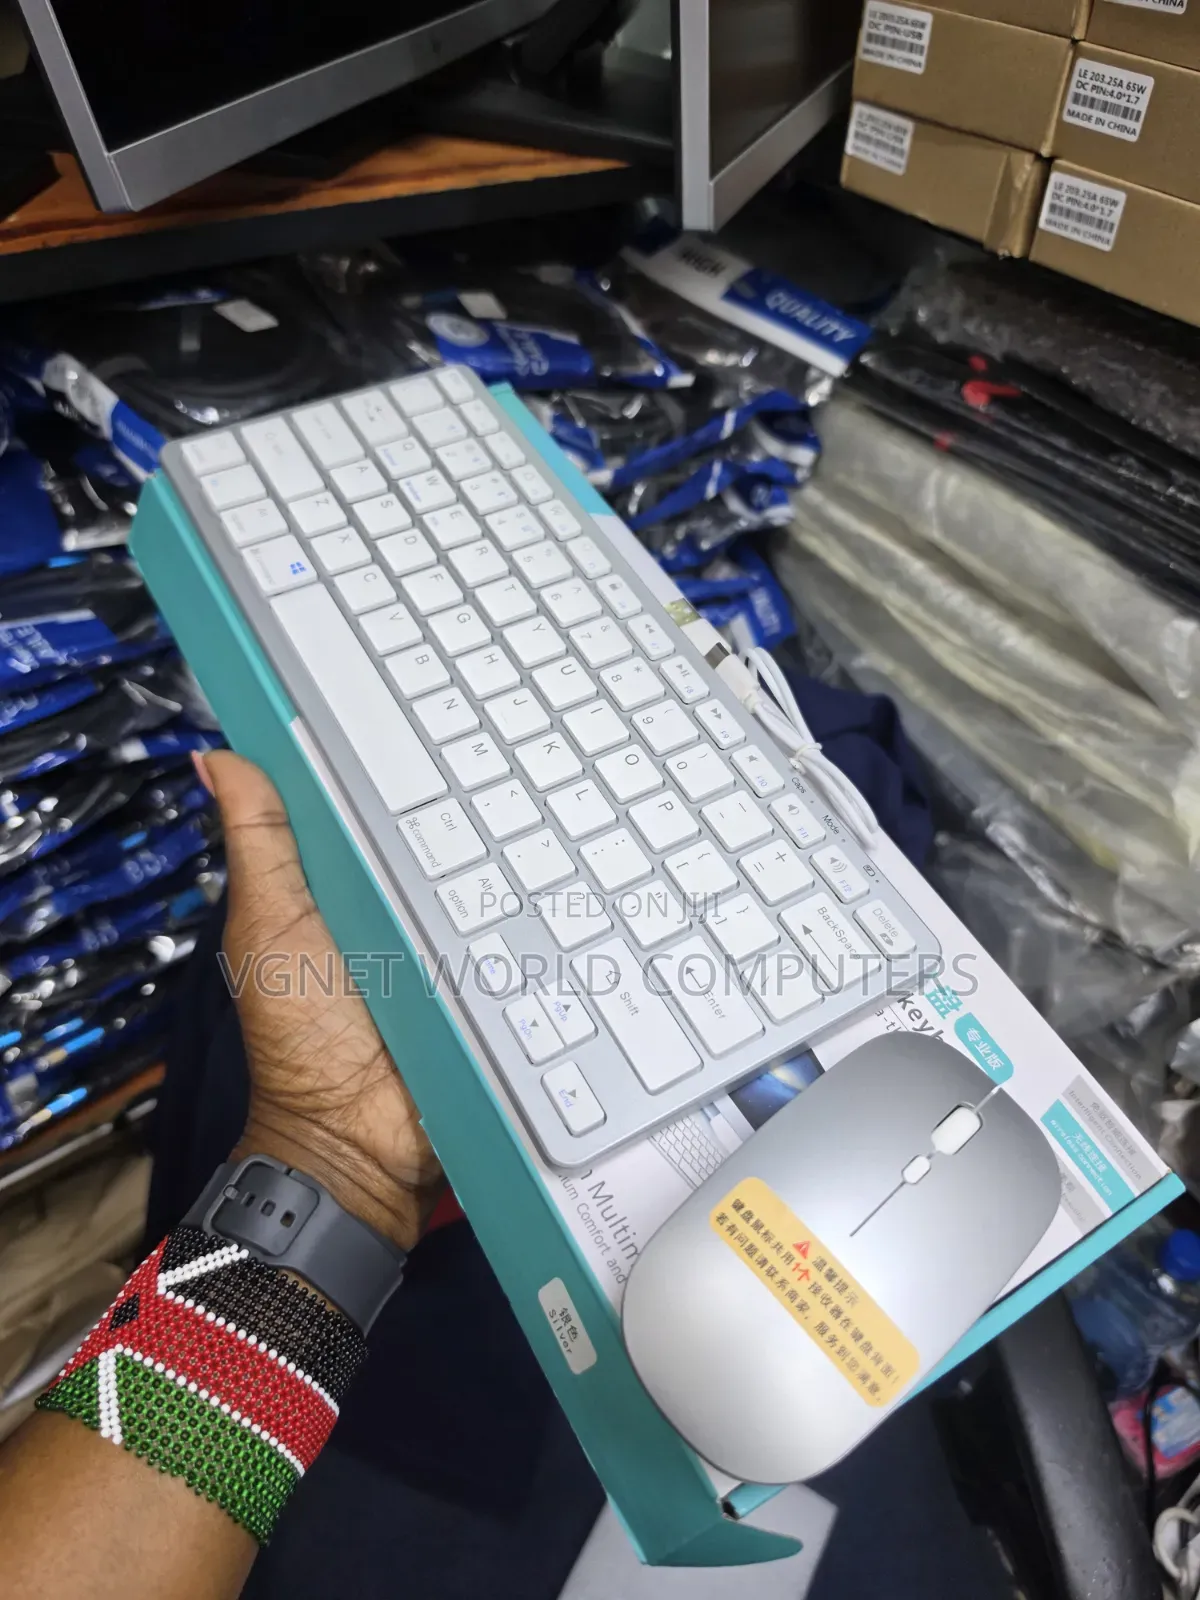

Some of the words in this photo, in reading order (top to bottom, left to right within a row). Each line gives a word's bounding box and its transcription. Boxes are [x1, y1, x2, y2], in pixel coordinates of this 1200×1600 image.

[1075, 80, 1089, 91] DC
[1078, 68, 1089, 79] LE
[1125, 81, 1148, 95] 65W
[1066, 108, 1094, 123] MADE
[1094, 116, 1106, 127] IN
[1107, 121, 1138, 136] CHINA
[765, 288, 857, 343] QUALITY
[426, 475, 441, 487] W
[380, 500, 394, 509] S
[449, 510, 463, 520] E
[338, 533, 352, 544] X
[404, 534, 418, 547] D
[475, 545, 490, 556] R
[363, 573, 378, 583] C
[429, 573, 445, 583] F
[503, 584, 517, 593] T
[550, 593, 562, 602] 6
[388, 611, 404, 622] V
[456, 612, 471, 624] G
[532, 623, 547, 633] Y
[580, 632, 592, 640] 7
[414, 653, 430, 665] B
[483, 652, 499, 665] H
[560, 663, 577, 676] U
[611, 674, 622, 683] 8
[442, 698, 459, 710] N
[513, 698, 528, 706] J
[642, 716, 654, 725] 9
[471, 742, 489, 757] M
[542, 741, 560, 755] K
[755, 775, 769, 788] F10
[790, 776, 807, 795] Caps
[575, 788, 589, 801] L
[657, 800, 675, 811] P
[439, 812, 458, 832] Ctrl
[821, 814, 840, 835] Mode
[797, 827, 810, 840] F11
[412, 828, 442, 869] command
[775, 851, 787, 863] +
[478, 877, 494, 892] Alt
[839, 879, 853, 892] F12
[448, 889, 470, 919] option
[872, 907, 899, 938] Delete
[816, 906, 861, 960] BackSpace
[619, 991, 640, 1016] Shift
[703, 991, 727, 1020] Enter
[553, 1001, 568, 1022] PgUp
[966, 1027, 1005, 1070] 专业版
[558, 1088, 574, 1109] End
[576, 1202, 612, 1256] Comfort
[606, 1258, 628, 1285] and
[812, 1255, 860, 1308] 温馨提示
[559, 1307, 579, 1343] 银色
[548, 1309, 572, 1355] Silver
